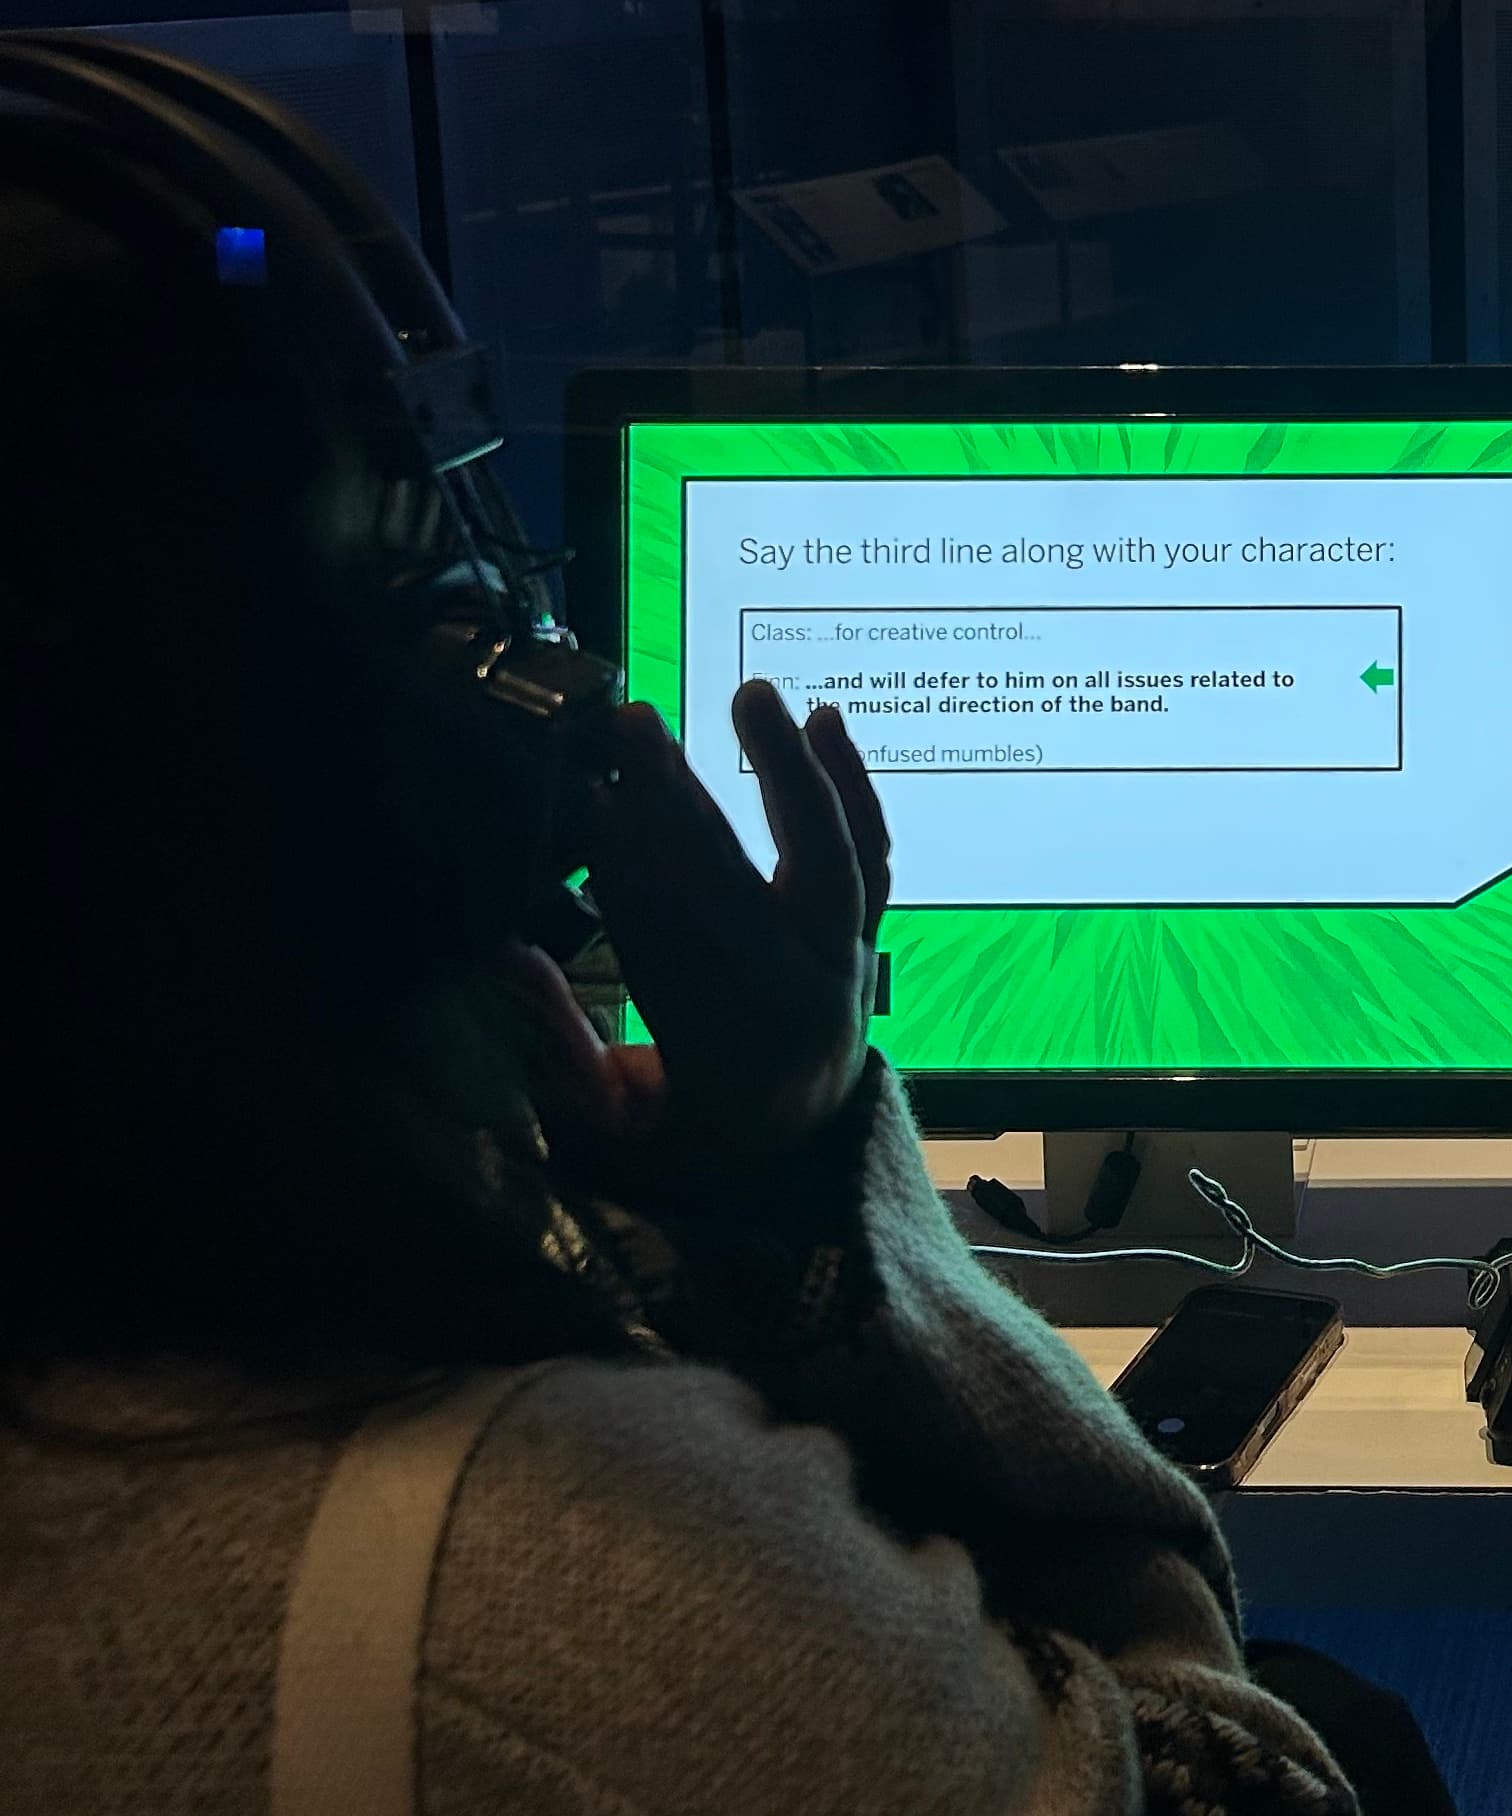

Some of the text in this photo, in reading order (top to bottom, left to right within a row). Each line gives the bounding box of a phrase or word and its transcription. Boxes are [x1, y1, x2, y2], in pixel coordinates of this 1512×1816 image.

[740, 535, 1394, 570] Say the third line along with your character:
[752, 621, 1042, 642] Class: ...for creative control...
[752, 670, 1295, 690] nn: ...and will defer to him on all issues related to
[847, 695, 931, 714] musical
[938, 695, 1033, 714] direction
[1041, 695, 1062, 713] of
[1069, 695, 1104, 713] the
[1111, 694, 1169, 713] band.
[857, 743, 1043, 766] onfused mumbles)
